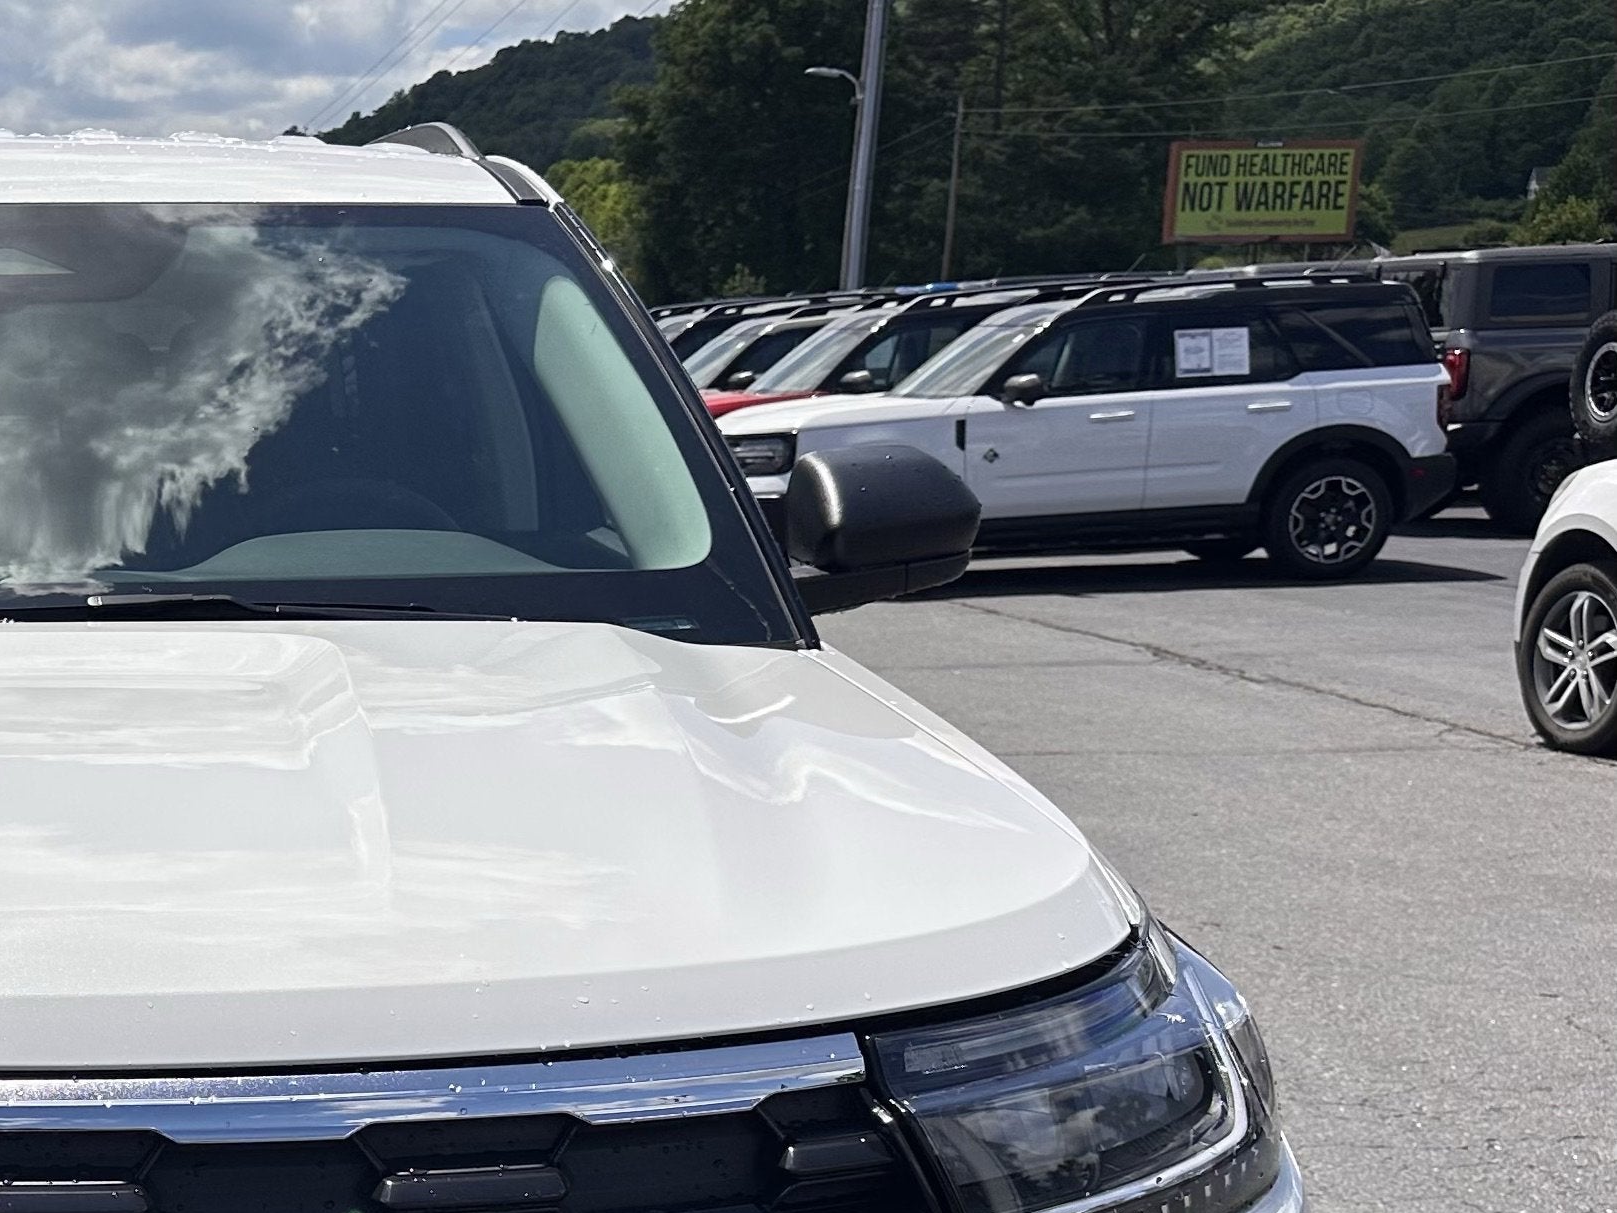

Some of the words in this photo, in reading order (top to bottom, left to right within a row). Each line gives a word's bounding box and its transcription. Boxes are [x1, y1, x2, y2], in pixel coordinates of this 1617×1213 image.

[1184, 155, 1230, 177] FUND
[1236, 153, 1349, 176] HEALTHCARE
[1181, 181, 1229, 212] NOT
[1235, 180, 1346, 212] WARFARE
